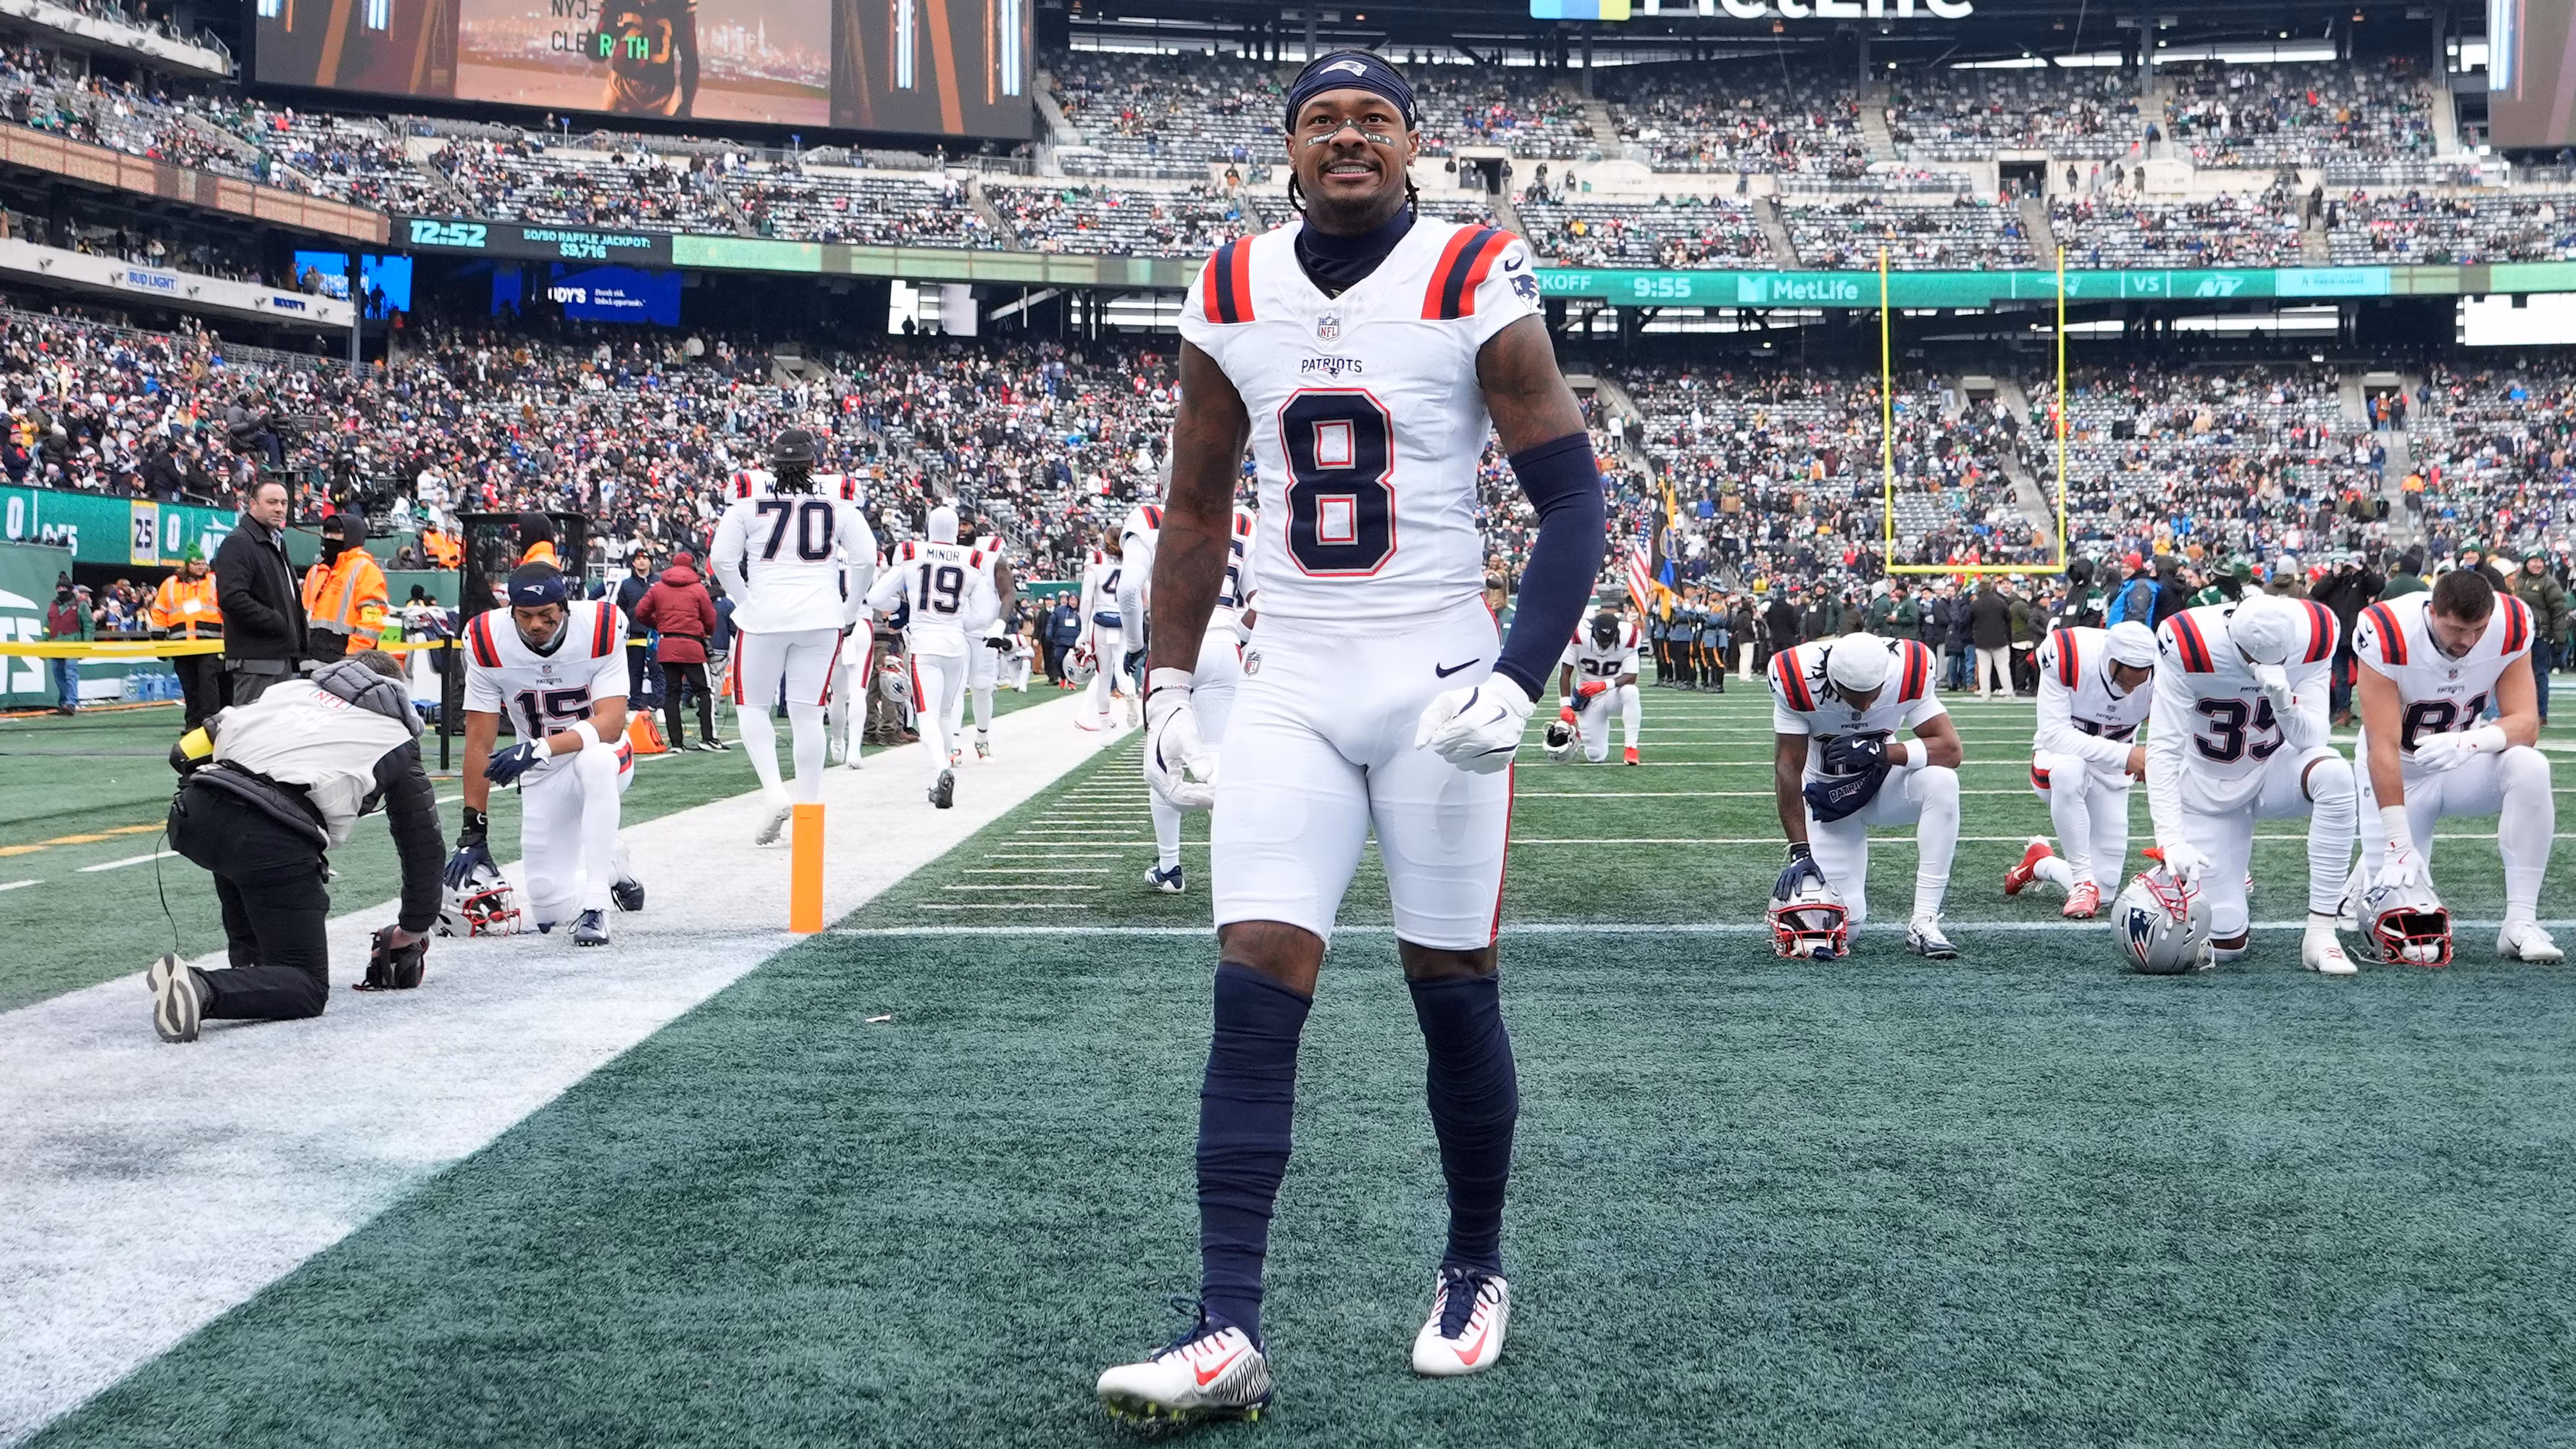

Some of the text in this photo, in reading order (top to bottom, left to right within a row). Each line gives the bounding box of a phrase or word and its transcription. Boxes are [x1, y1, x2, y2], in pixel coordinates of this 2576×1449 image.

[410, 220, 488, 248] 12:52
[523, 228, 651, 249] 50/50 RAFFLE JACKPOT:
[560, 242, 607, 259] $9,716
[129, 272, 176, 290] BUD LIGHT
[1634, 277, 1691, 297] 9:55
[1773, 279, 1859, 301] MetLife
[2133, 276, 2159, 292] VS
[1301, 357, 1363, 374] PATRIOTS
[1277, 387, 1398, 577] 8
[135, 518, 153, 548] 25
[166, 513, 181, 552] 0
[756, 498, 836, 563] 70
[926, 548, 961, 562] MINOR
[917, 561, 966, 615] 19
[314, 690, 346, 711] NFL
[514, 684, 595, 740] 15
